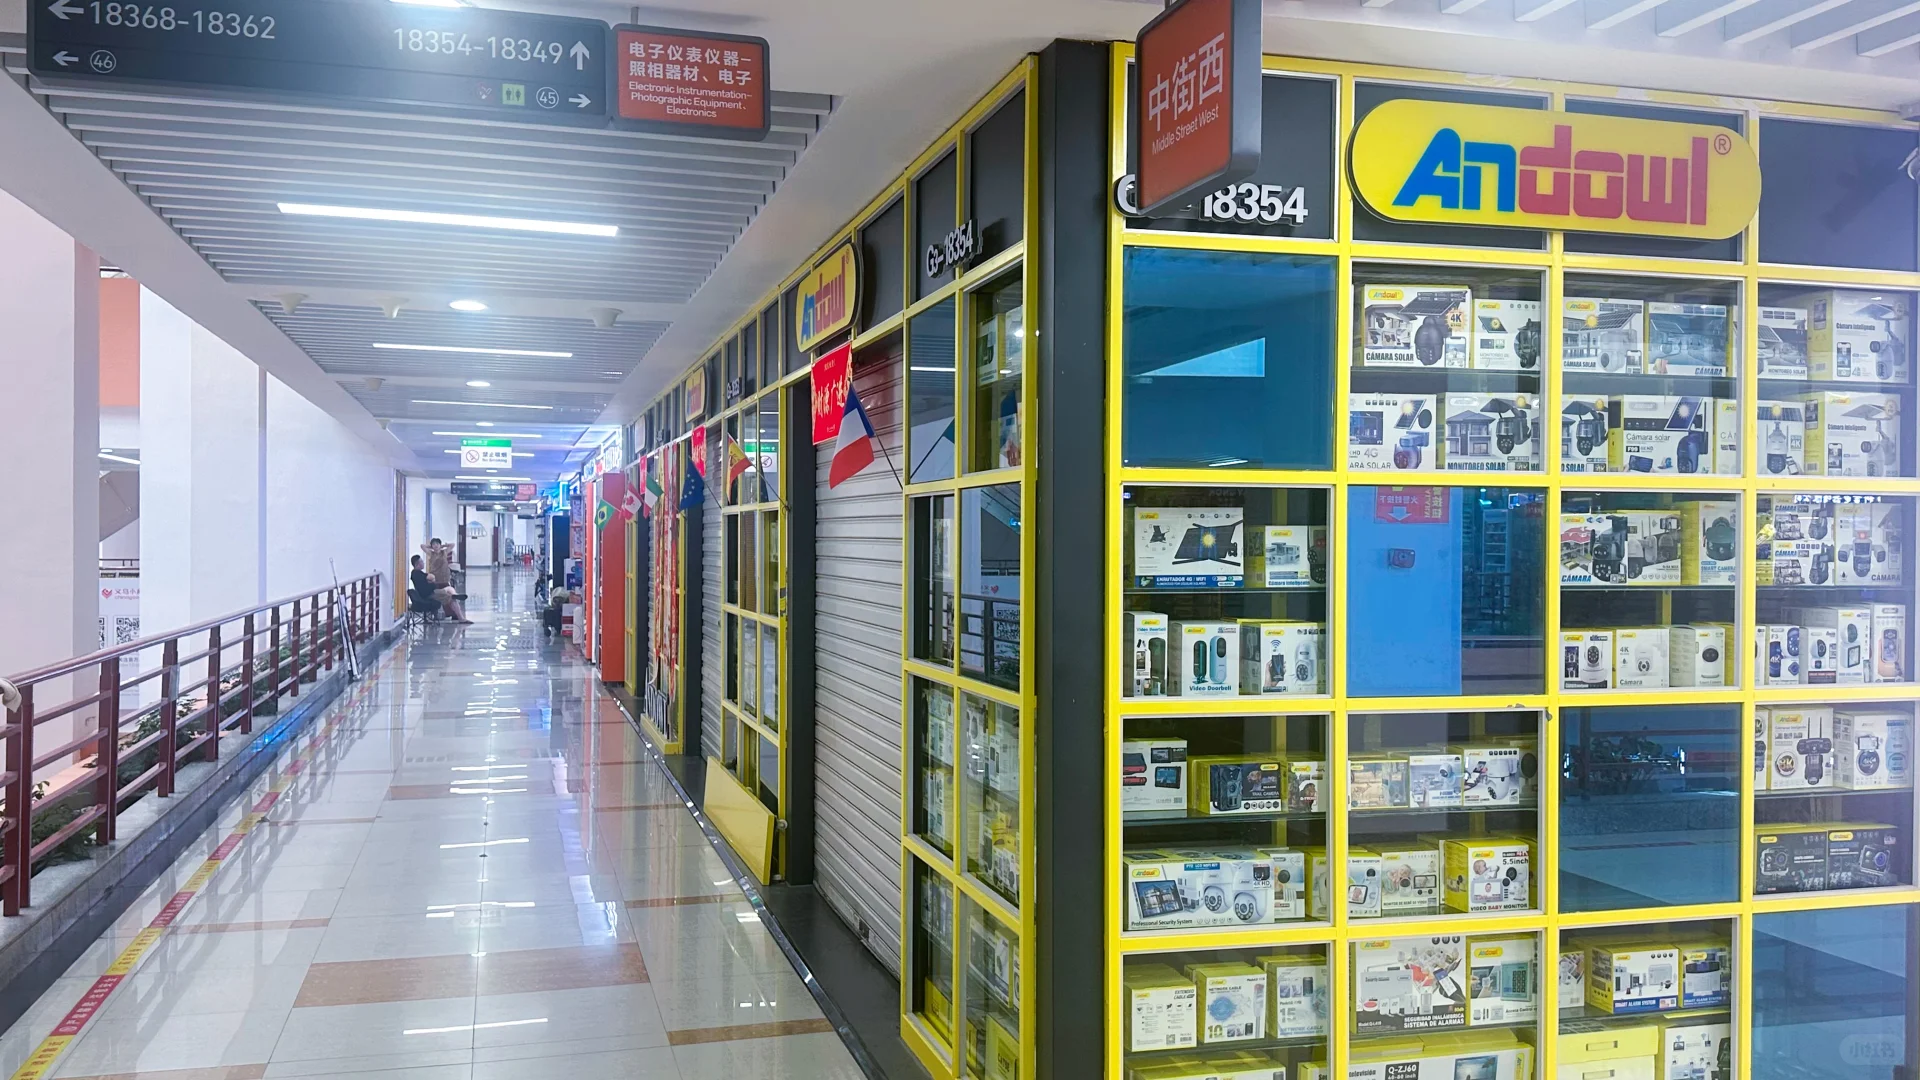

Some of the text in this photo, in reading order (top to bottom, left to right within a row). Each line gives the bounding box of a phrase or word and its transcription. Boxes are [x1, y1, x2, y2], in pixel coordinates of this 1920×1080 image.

[90, 1, 275, 39] 18368-18362
[394, 28, 563, 65] 18354-18349
[93, 54, 112, 69] 46
[629, 61, 752, 85] 照相器材、电子
[629, 82, 675, 93] Electronic
[1148, 32, 1224, 131] 中街西
[538, 91, 557, 105] 45
[631, 92, 692, 105] Photographic
[667, 106, 716, 117] Electronics
[1152, 105, 1219, 155] Middle Street West
[1392, 125, 1709, 225] Andowl
[926, 220, 973, 277] G3-18354
[801, 256, 845, 344] Andowl
[1450, 314, 1461, 322] 4K
[1366, 352, 1393, 361] CÁMARA
[1564, 360, 1581, 368] CÁMARA
[1626, 433, 1652, 441] Cámara
[1486, 463, 1505, 471] SOLAR
[1566, 464, 1584, 472] SOLAR
[1562, 574, 1591, 582] CÁMARA
[1388, 1065, 1416, 1073] Q-ZJ60
